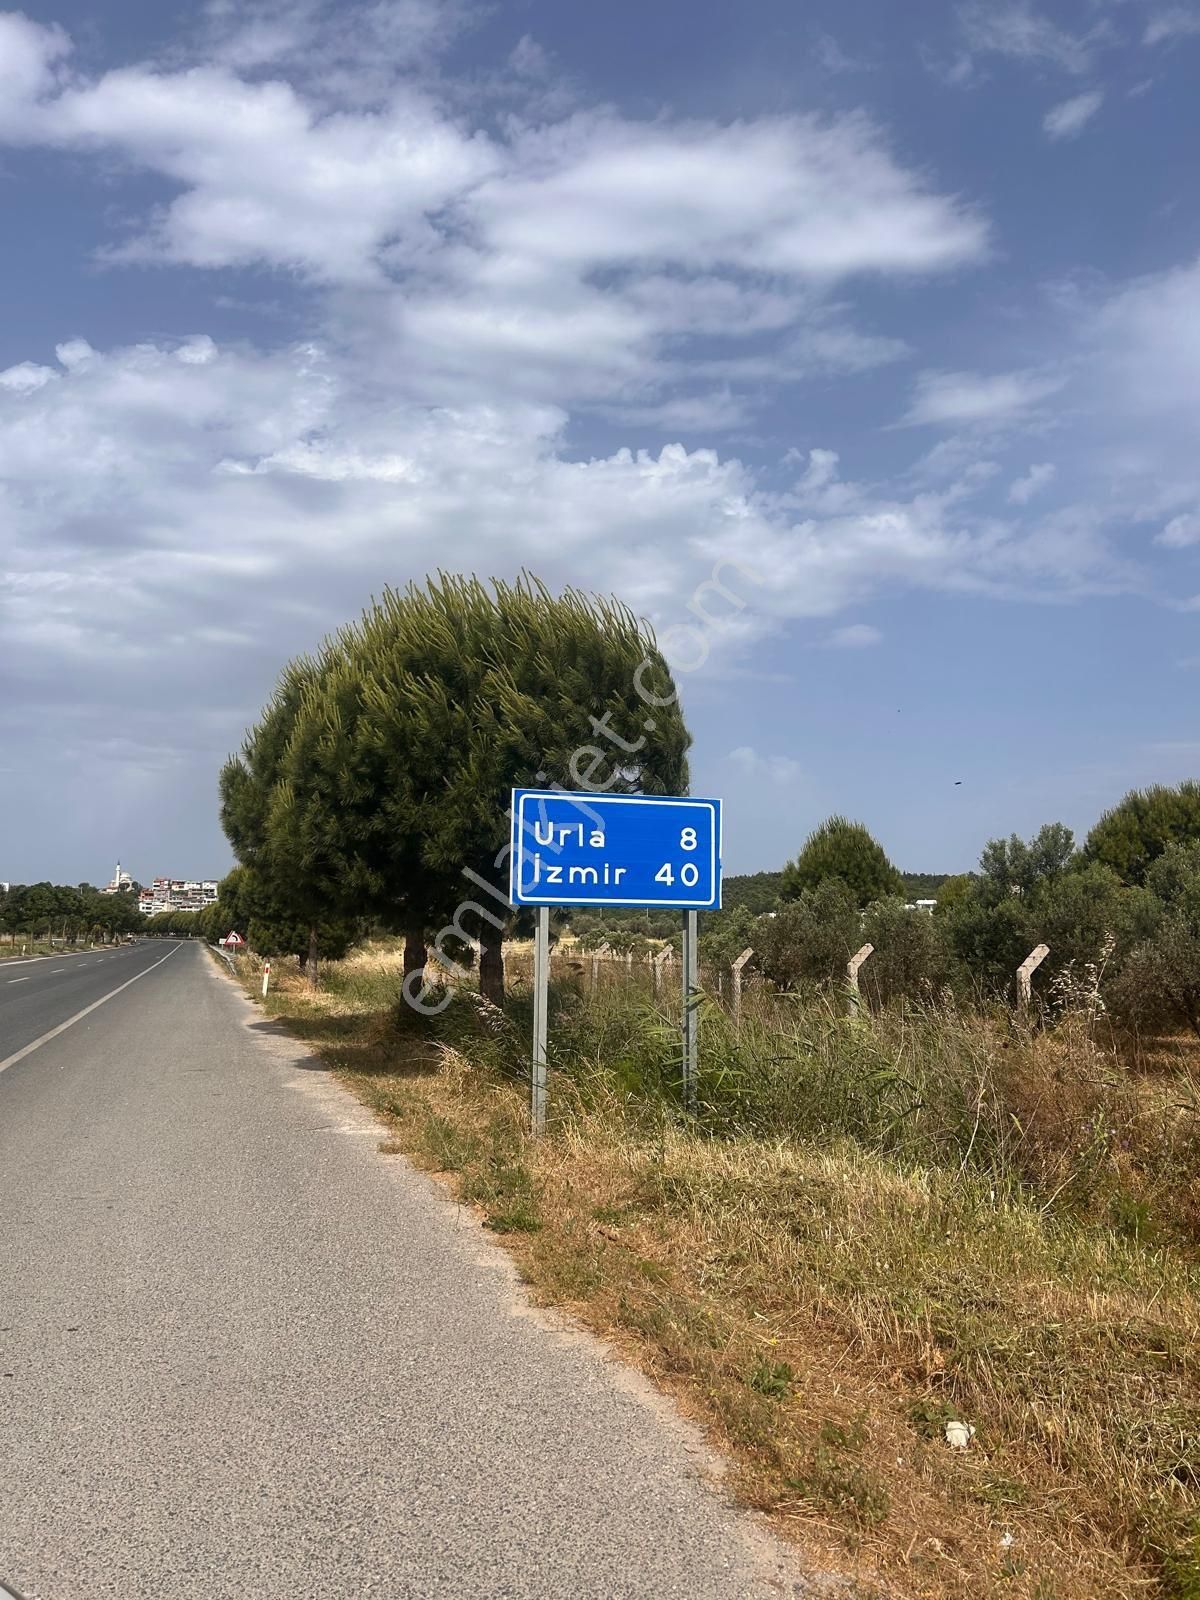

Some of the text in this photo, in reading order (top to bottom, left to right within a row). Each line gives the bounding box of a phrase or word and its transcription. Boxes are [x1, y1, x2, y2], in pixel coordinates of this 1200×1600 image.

[534, 821, 698, 851] Urla 8
[533, 853, 699, 887] İzmir 40
